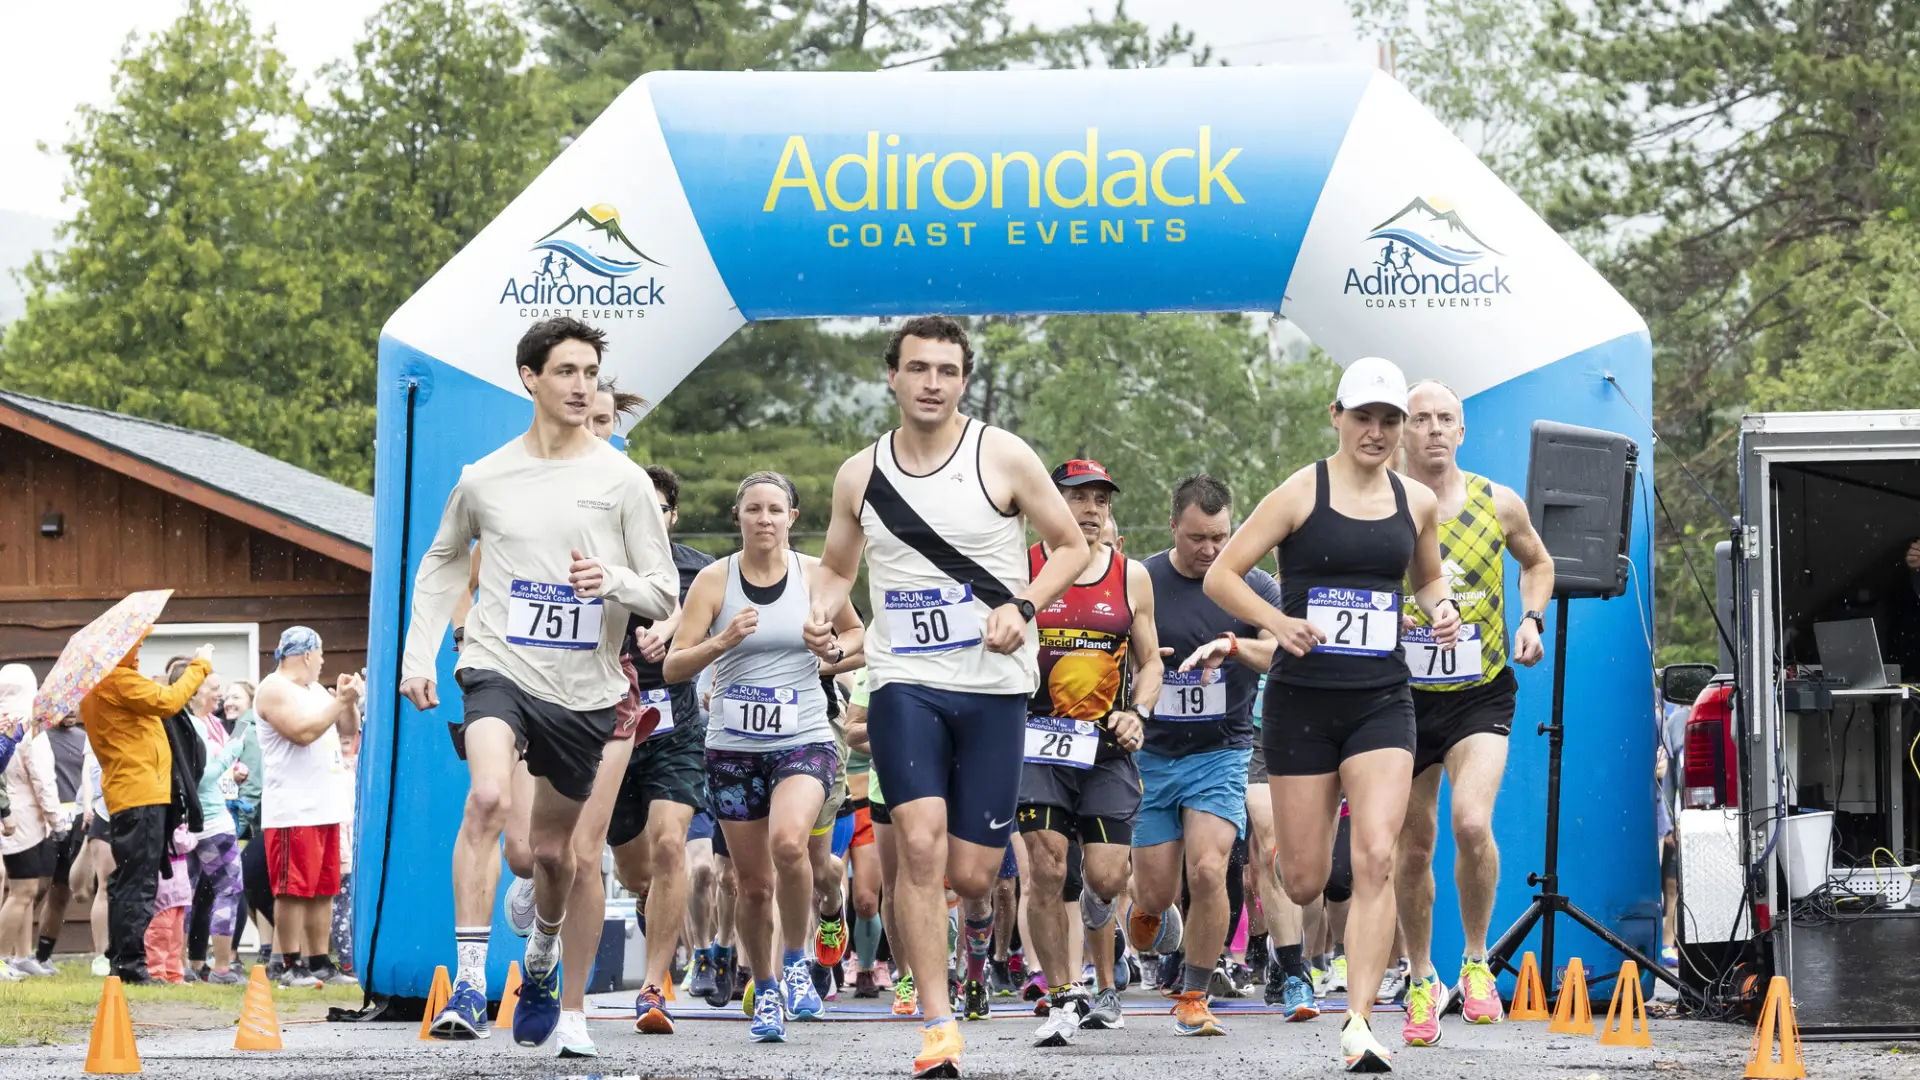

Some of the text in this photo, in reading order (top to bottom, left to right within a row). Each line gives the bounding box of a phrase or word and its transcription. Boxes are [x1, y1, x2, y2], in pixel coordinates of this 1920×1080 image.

[763, 125, 1246, 212] Adirondack
[828, 218, 1187, 248] COAST EVENTS
[1343, 265, 1512, 295] Adirondack
[499, 276, 666, 306] Adirondack
[1365, 297, 1492, 308] COAST EVENTS
[519, 308, 645, 319] COAST EVENTS
[530, 583, 557, 595] RUN
[1328, 589, 1355, 601] RUN
[511, 590, 551, 601] Adirondack
[899, 592, 924, 602] RUN
[922, 599, 943, 607] Coast
[1308, 598, 1350, 607] Adirondack
[528, 602, 580, 640] 751
[912, 609, 949, 644] 50
[1335, 610, 1368, 646] 21
[1416, 627, 1432, 638] RU
[1075, 638, 1112, 649] Planet
[1424, 645, 1456, 676] 70
[1168, 670, 1189, 680] RUN
[724, 692, 756, 700] Adirondack
[739, 686, 760, 697] RUN
[1177, 686, 1204, 714] 19
[740, 703, 782, 733] 104
[1040, 733, 1073, 758] 26
